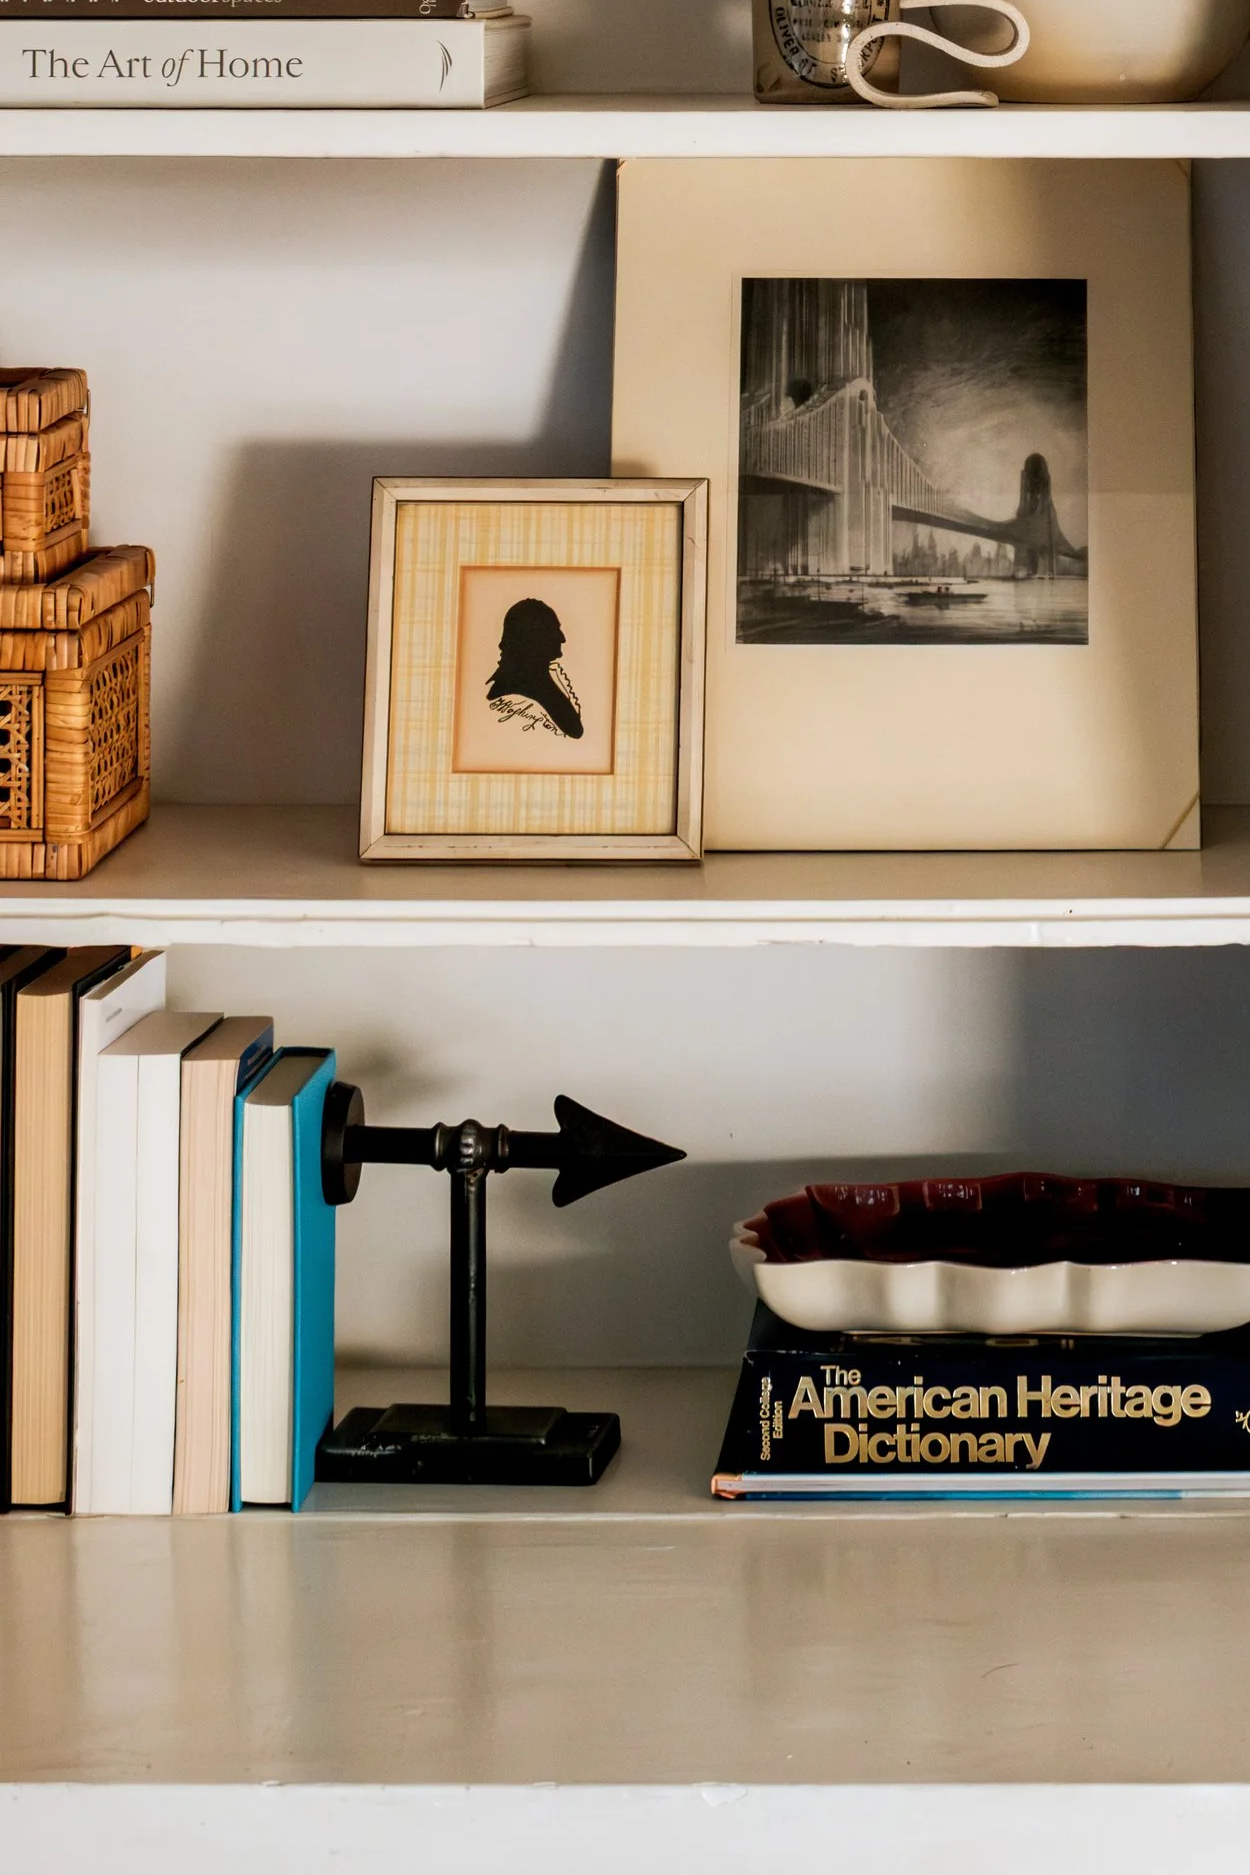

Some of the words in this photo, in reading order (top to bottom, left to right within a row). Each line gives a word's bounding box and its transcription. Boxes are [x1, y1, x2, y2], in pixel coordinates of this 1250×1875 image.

[22, 49, 88, 78] The
[97, 50, 151, 78] Art
[162, 49, 194, 86] of
[198, 49, 303, 78] Home
[821, 1366, 861, 1385] The
[760, 1376, 772, 1418] College
[788, 1375, 1004, 1418] American
[1017, 1375, 1211, 1426] Heritage
[773, 1400, 783, 1438] Edition
[760, 1420, 770, 1460] Second
[824, 1423, 1051, 1469] Dictionary
